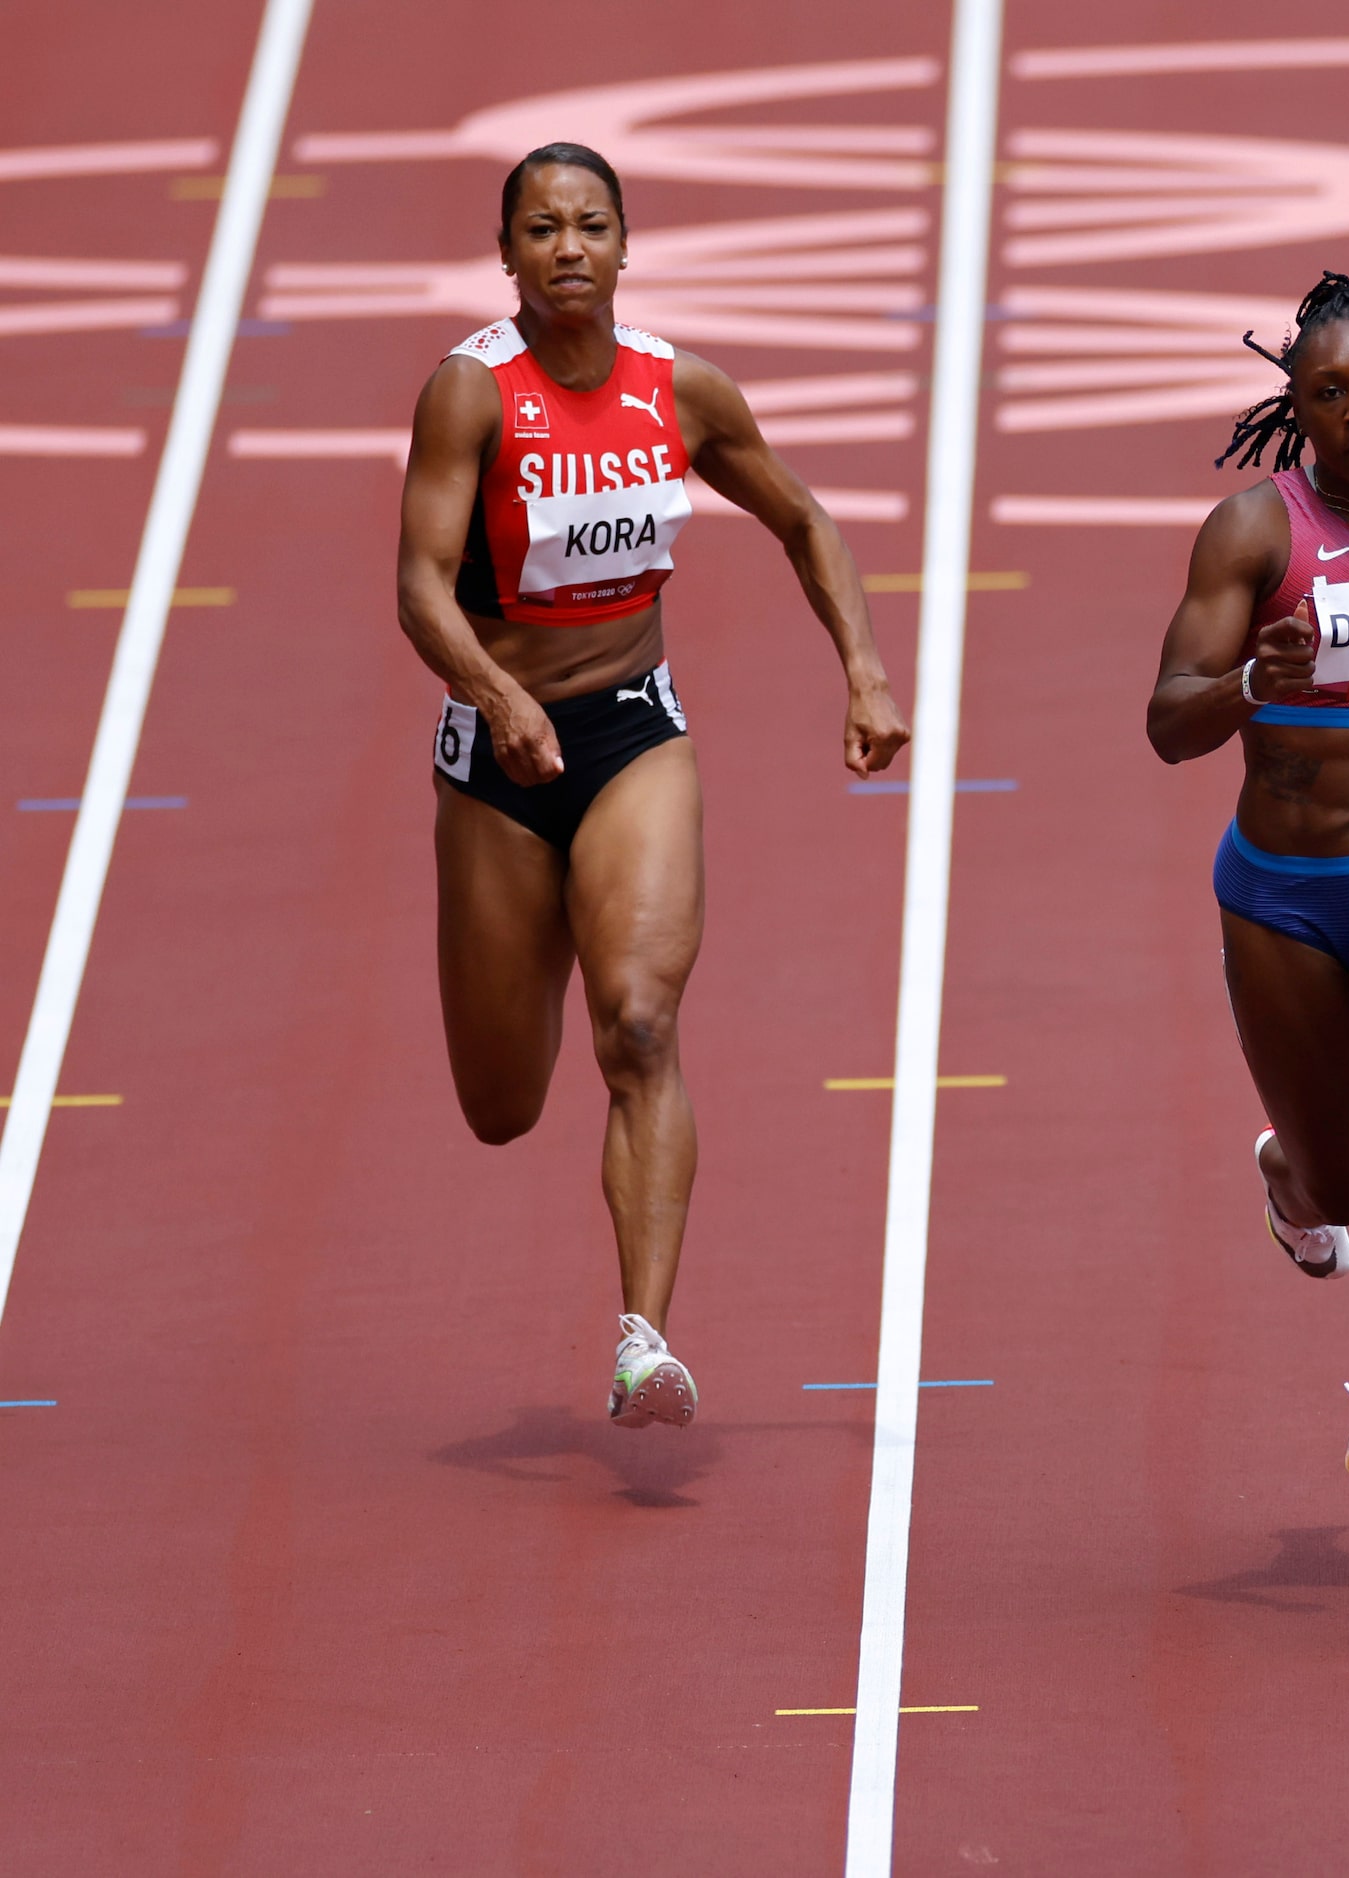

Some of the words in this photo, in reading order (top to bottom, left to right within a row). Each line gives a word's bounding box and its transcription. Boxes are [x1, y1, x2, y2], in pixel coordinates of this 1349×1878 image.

[517, 444, 672, 500] SUISSE
[565, 514, 656, 557] KORA
[572, 591, 597, 600] TOKYO
[597, 588, 616, 598] 2020
[440, 706, 460, 766] 6
